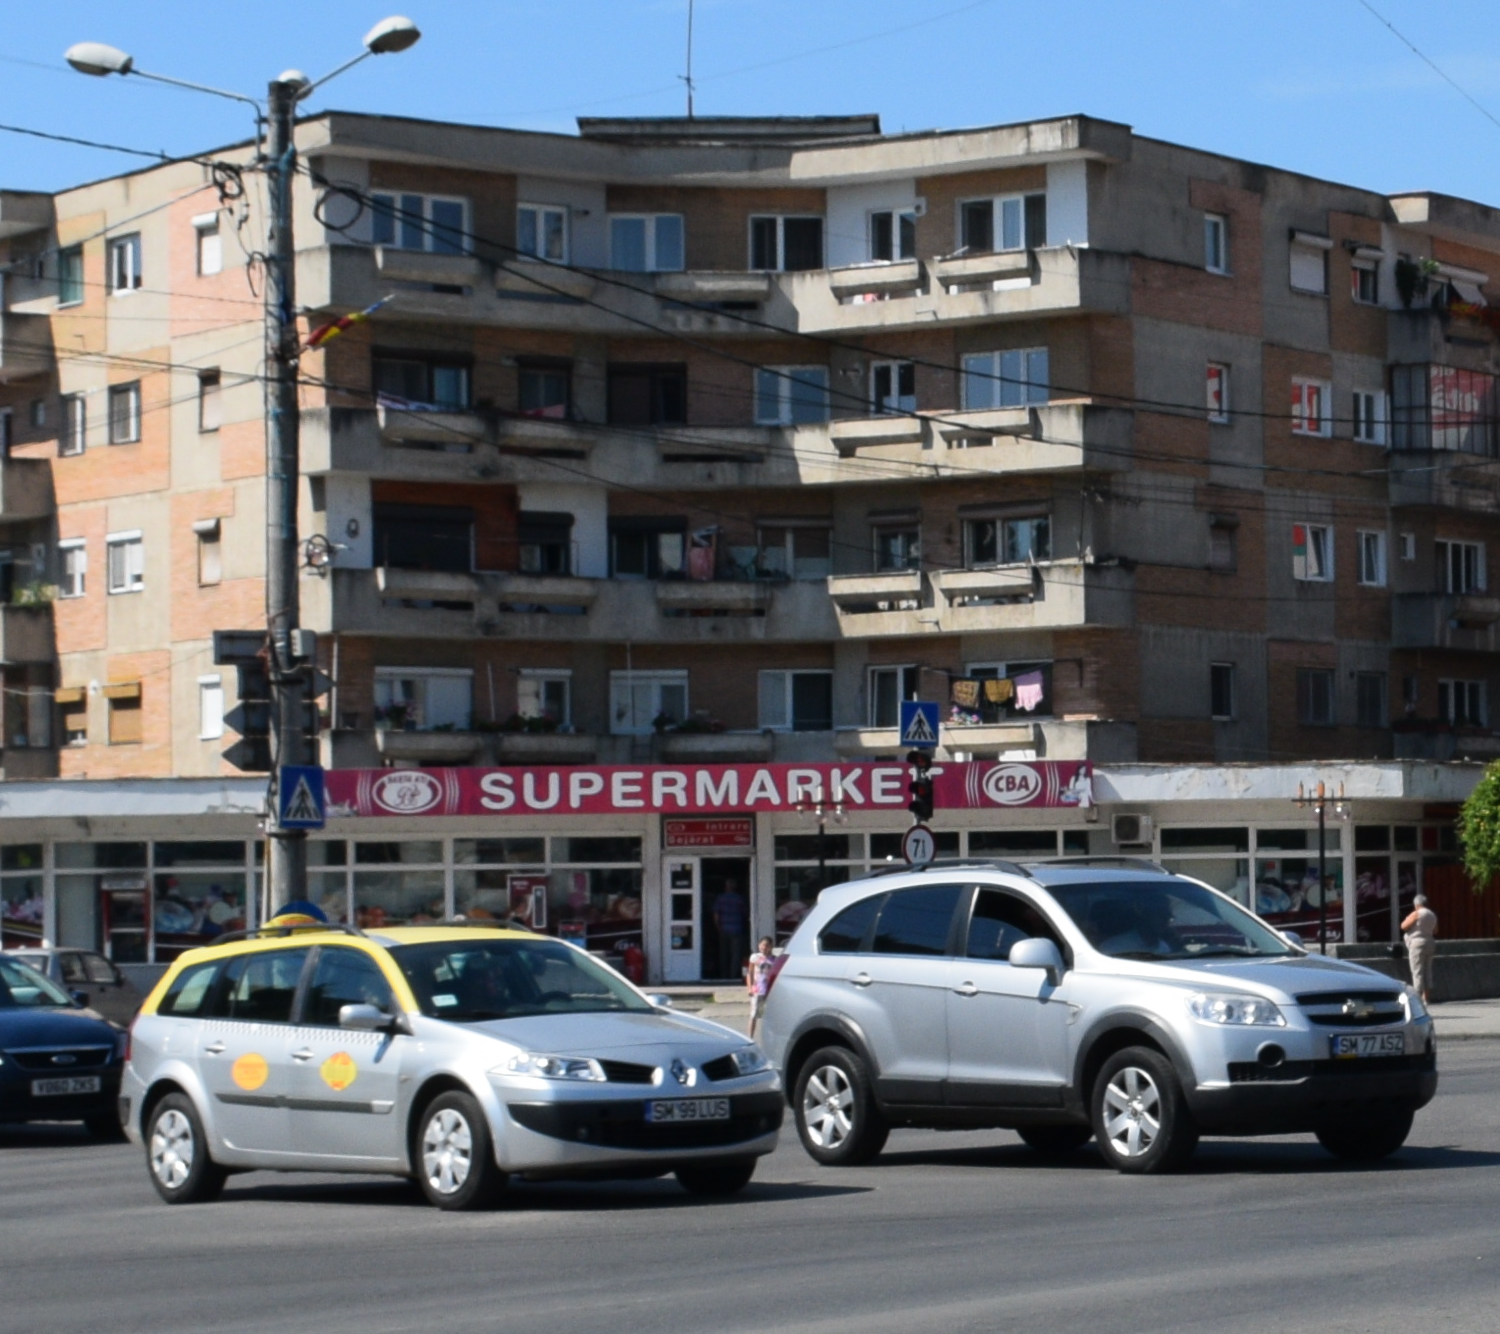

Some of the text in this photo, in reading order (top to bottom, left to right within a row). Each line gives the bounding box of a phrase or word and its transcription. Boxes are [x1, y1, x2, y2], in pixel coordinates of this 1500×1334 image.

[993, 774, 1031, 793] CBA
[1340, 1034, 1403, 1053] SM 77 ASZ
[654, 1100, 727, 1120] SM 99 LUS
